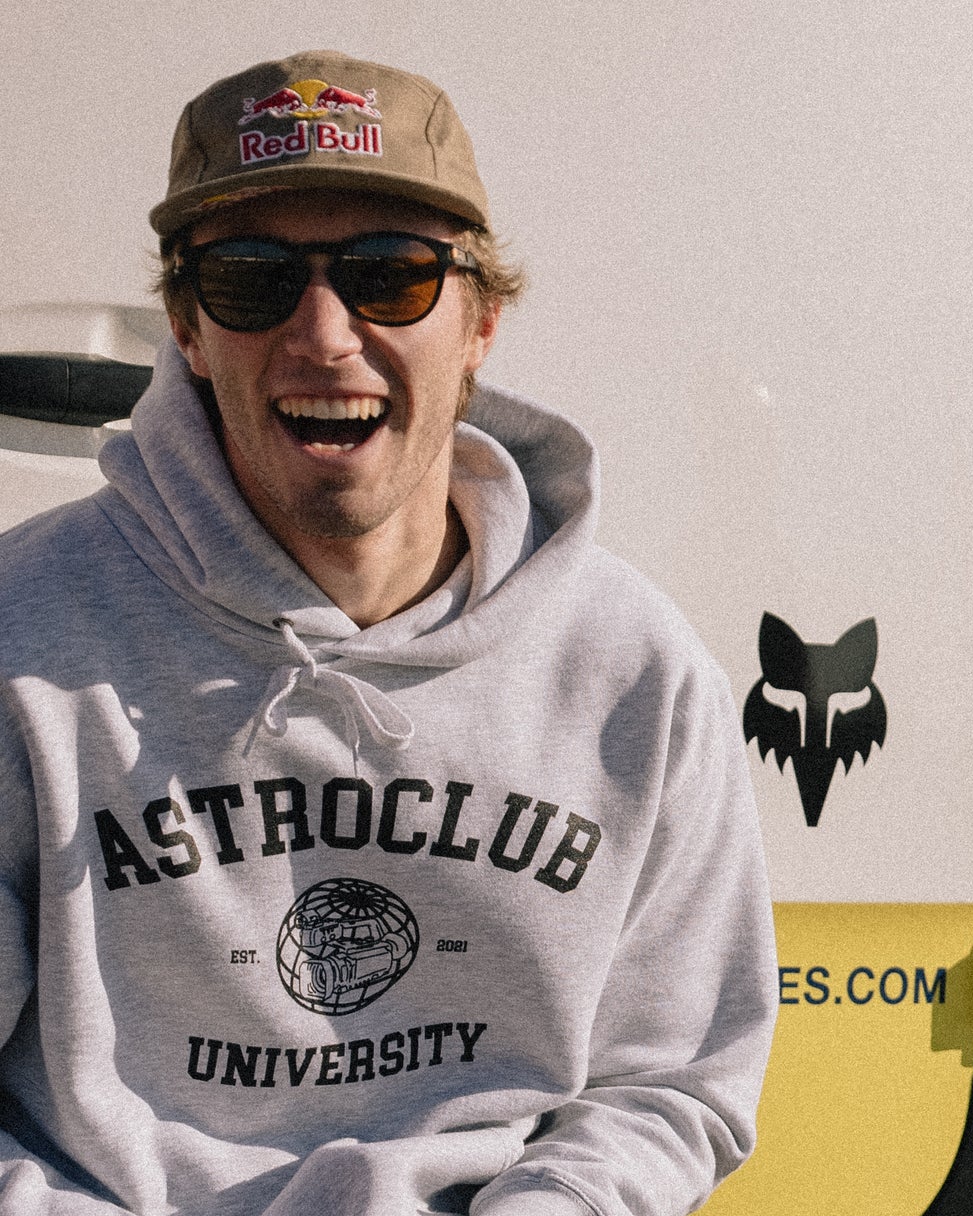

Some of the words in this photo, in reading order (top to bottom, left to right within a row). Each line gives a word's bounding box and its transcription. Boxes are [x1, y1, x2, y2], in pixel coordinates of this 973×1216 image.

[240, 121, 309, 164] Red
[315, 123, 383, 157] Bull
[93, 776, 602, 894] ASTROCLUB
[230, 949, 260, 964] EST.
[436, 939, 468, 953] 2021
[778, 966, 947, 1005] ES.COM
[187, 1022, 488, 1088] UNIVERSITY
